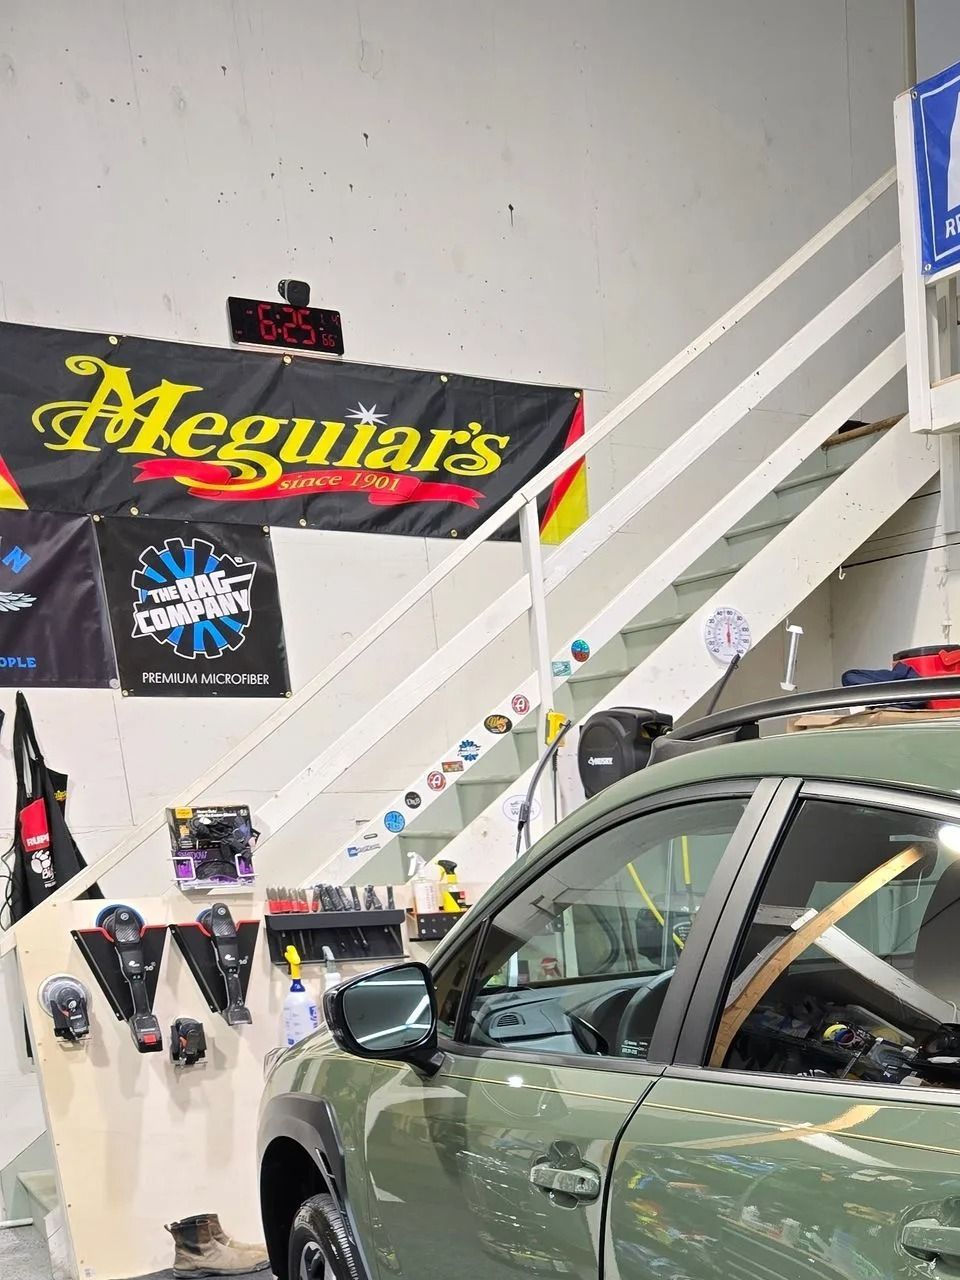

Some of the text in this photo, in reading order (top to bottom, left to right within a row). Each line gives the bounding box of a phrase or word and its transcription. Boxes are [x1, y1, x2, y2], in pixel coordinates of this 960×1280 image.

[257, 304, 317, 345] 6:25
[32, 355, 510, 490] Meguiar's
[279, 472, 401, 492] since 1901
[148, 570, 252, 604] THE RAG
[137, 589, 249, 634] COMPANY
[142, 672, 270, 685] PREMIUM MICROFIBER
